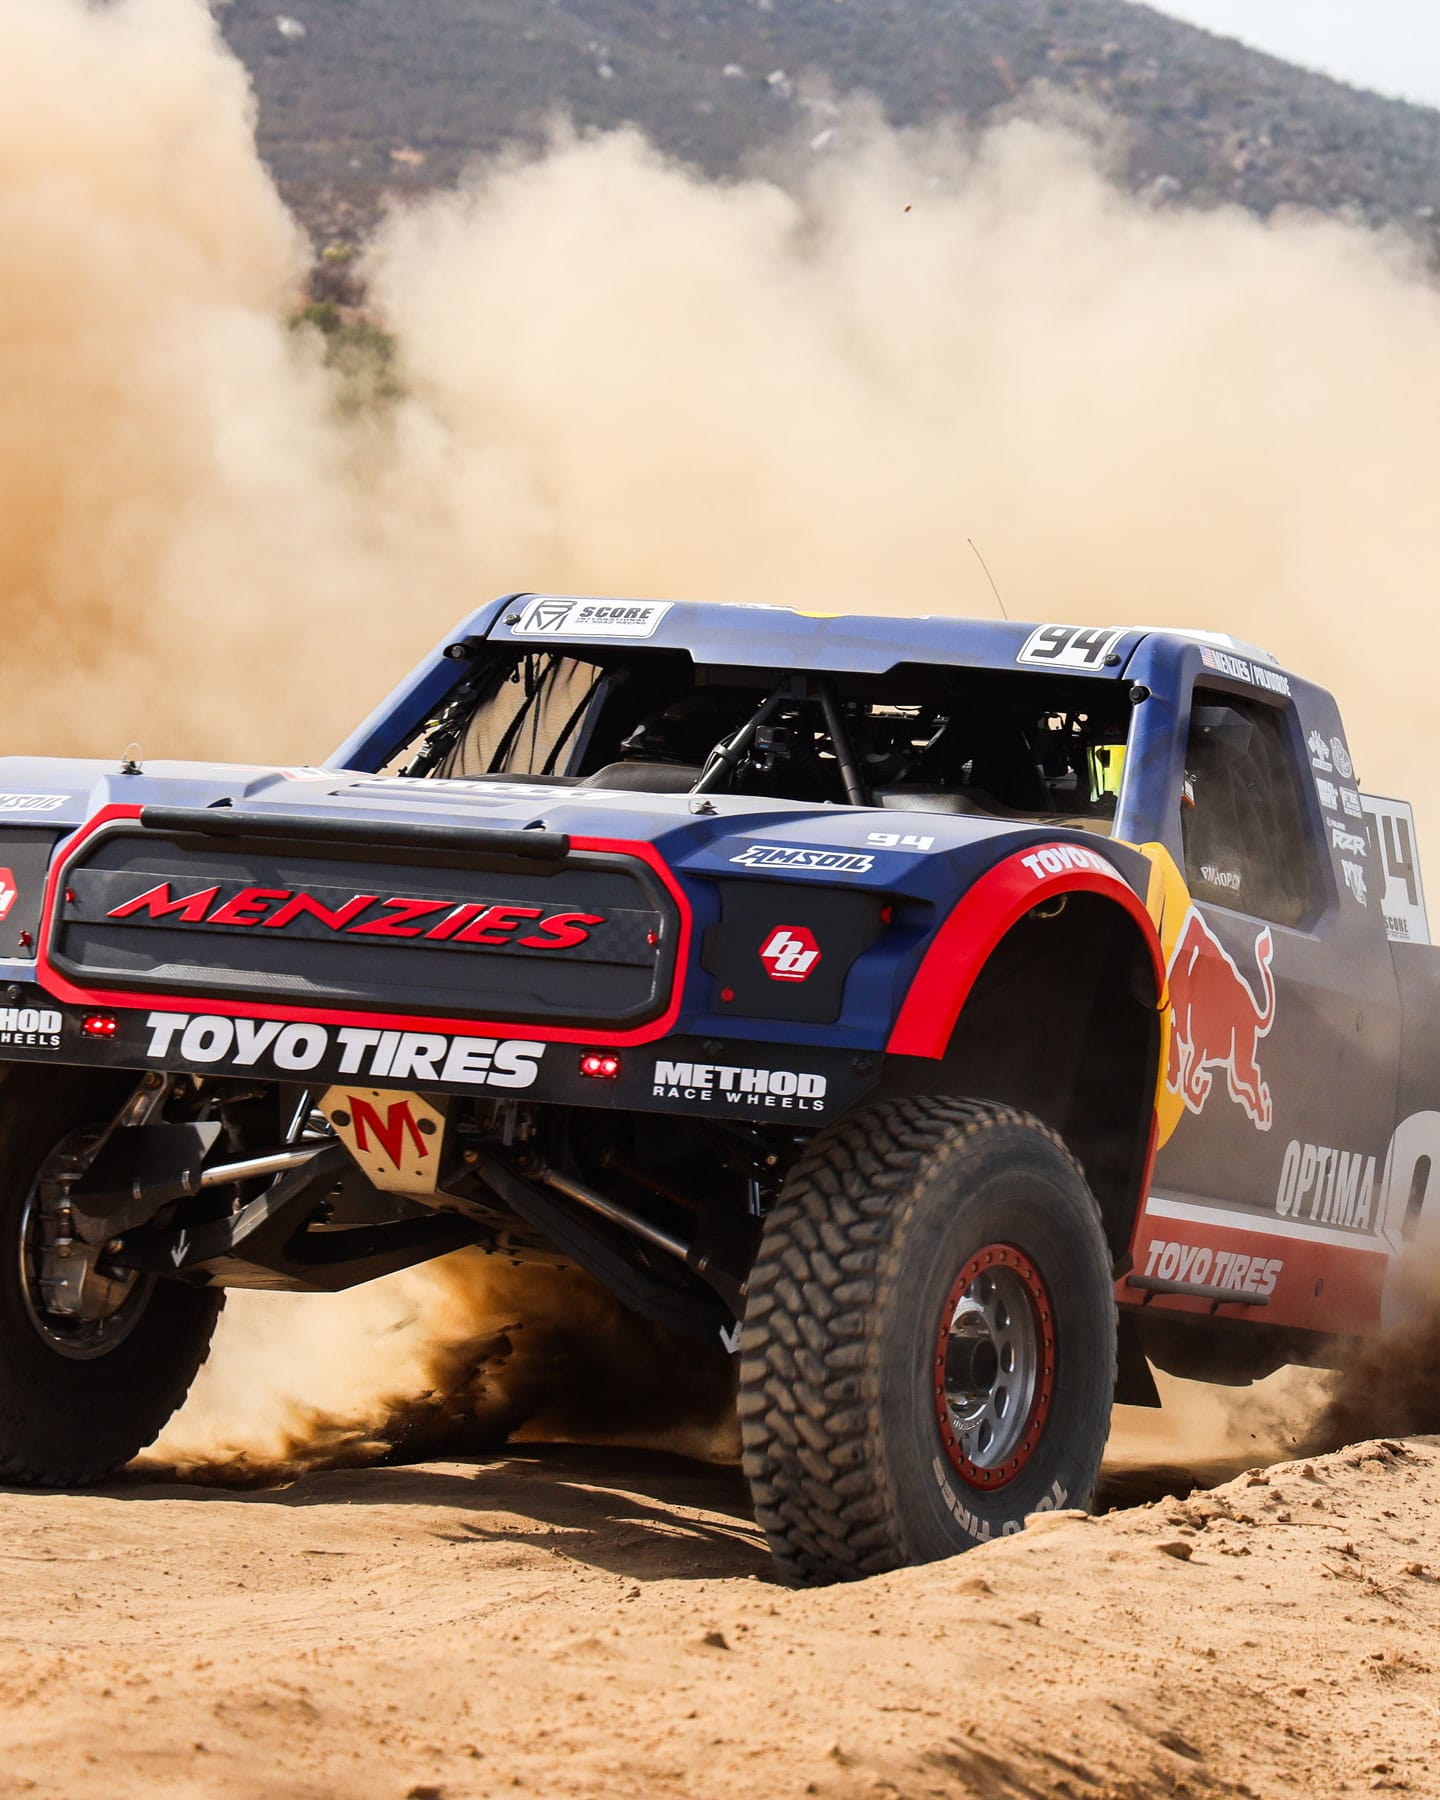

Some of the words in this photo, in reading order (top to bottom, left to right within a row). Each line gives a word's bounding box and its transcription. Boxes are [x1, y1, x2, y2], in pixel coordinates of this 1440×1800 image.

[579, 606, 655, 619] SCORE
[1030, 626, 1118, 663] 94
[734, 847, 873, 872] AMSOIL
[866, 832, 935, 850] 94
[1021, 846, 1091, 880] TOYO
[107, 882, 606, 949] MENZIES
[146, 1012, 327, 1071] TOYO
[337, 1027, 547, 1088] TIRES
[654, 1061, 827, 1098] METHOD
[653, 1086, 713, 1101] RACE
[726, 1092, 825, 1111] WHEELS
[1276, 1139, 1377, 1230] OPTIMA
[1144, 1239, 1213, 1285] TOYO
[1211, 1251, 1284, 1296] TIRES
